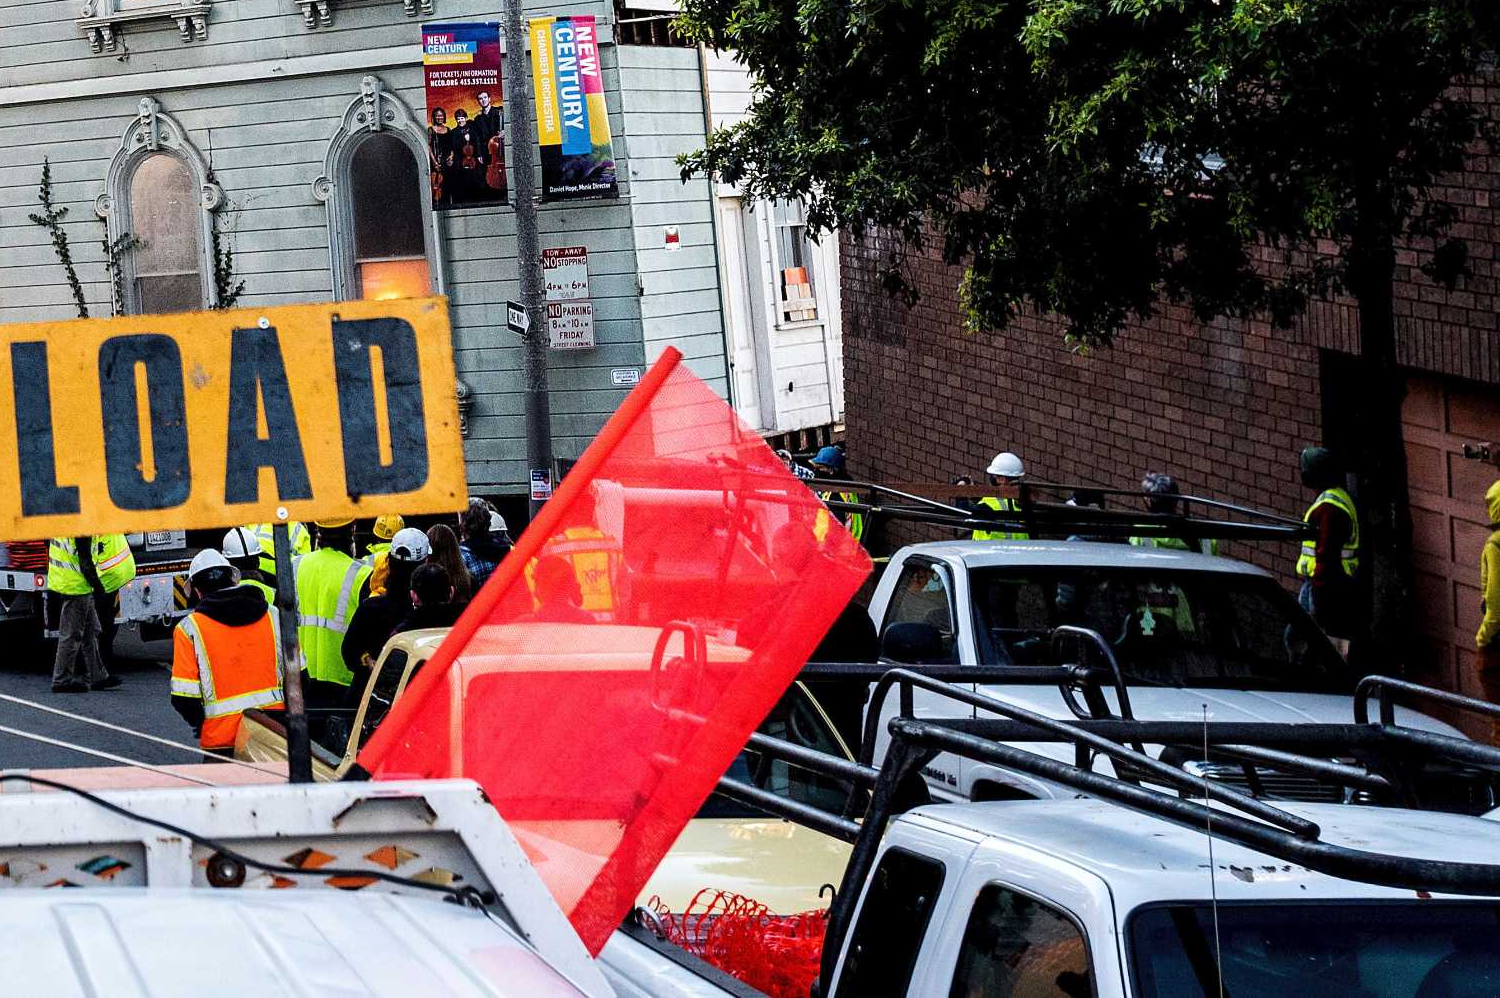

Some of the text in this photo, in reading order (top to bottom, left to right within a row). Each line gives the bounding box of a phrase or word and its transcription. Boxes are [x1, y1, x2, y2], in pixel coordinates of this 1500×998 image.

[427, 35, 448, 44] NEW
[427, 43, 468, 54] CENTURY
[575, 26, 597, 77] NEW
[430, 71, 440, 79] FOR
[536, 29, 555, 132] CHAMBER ORCHESTRA
[555, 27, 585, 130] CENTURY
[430, 79, 459, 87] NCCO.ORG
[549, 185, 565, 193] Daniel
[579, 183, 592, 191] Music
[543, 257, 587, 268] NO STOPPING
[548, 304, 592, 317] NO PARKING
[559, 331, 584, 340] FRIDAY
[11, 316, 430, 518] LOAD
